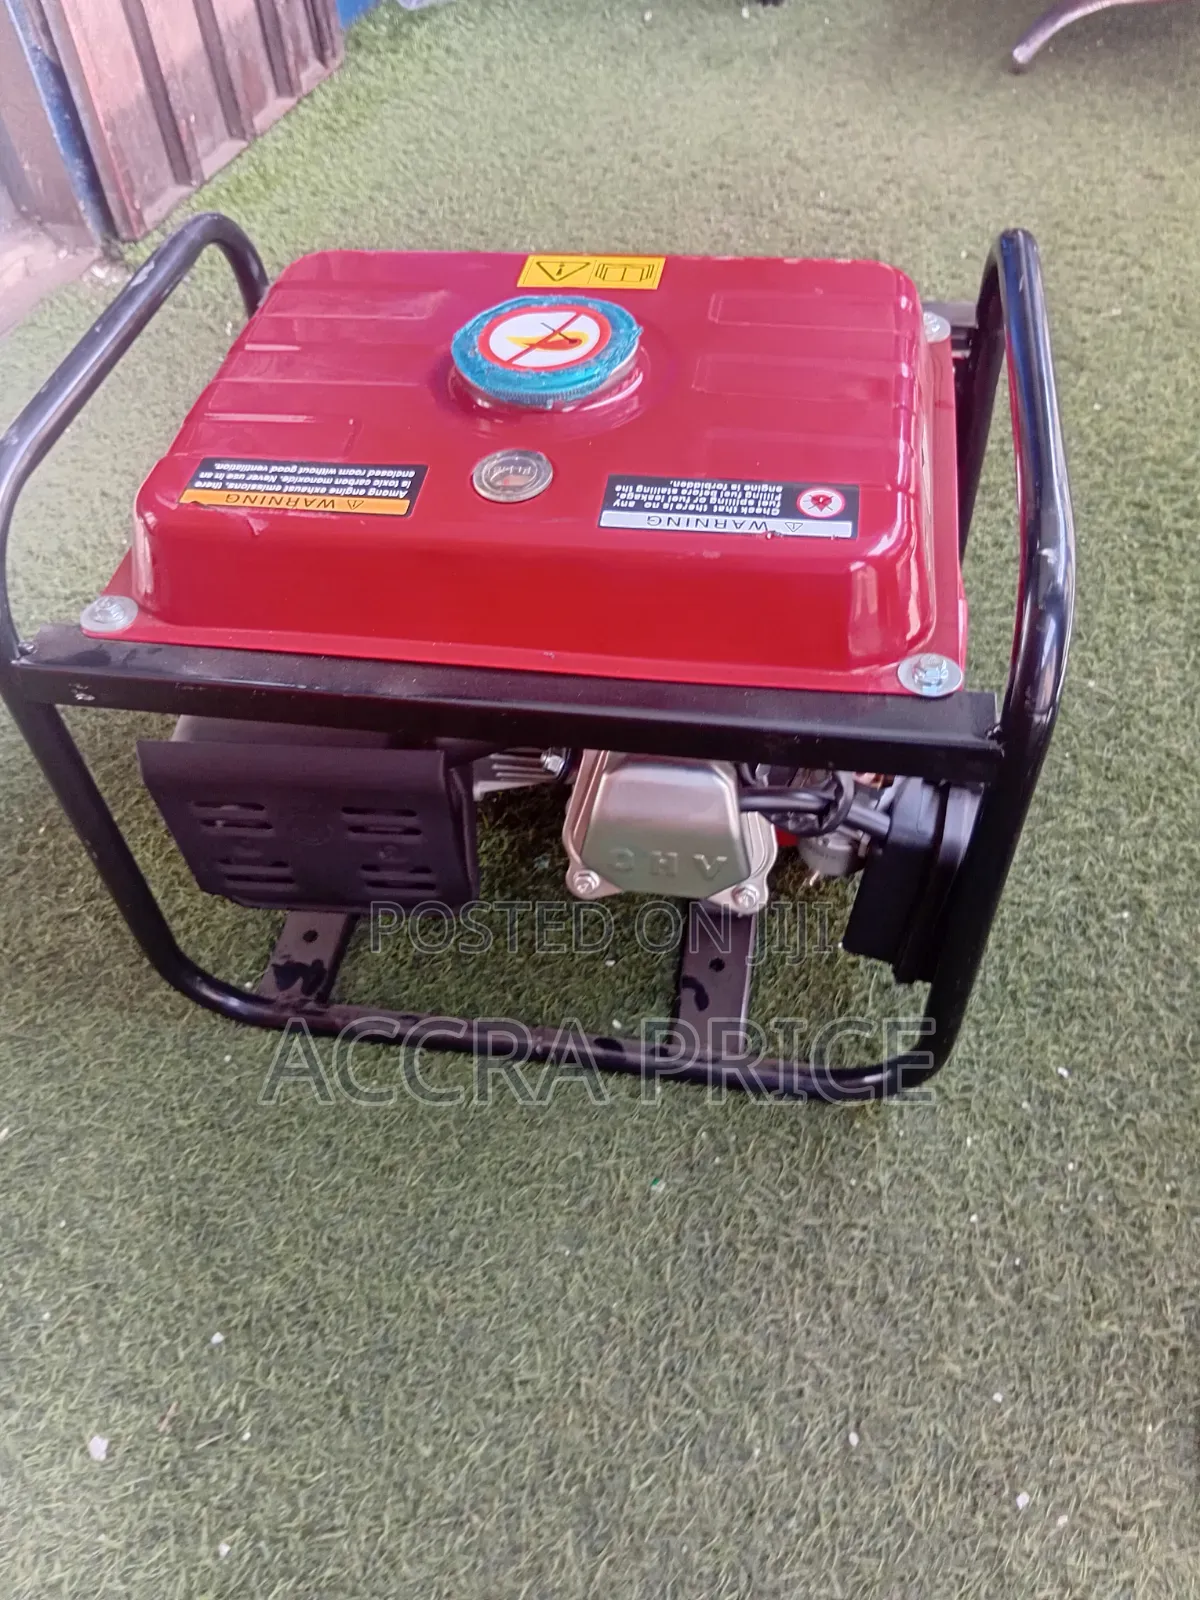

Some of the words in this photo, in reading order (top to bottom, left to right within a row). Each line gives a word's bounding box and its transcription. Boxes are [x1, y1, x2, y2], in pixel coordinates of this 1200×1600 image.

[268, 465, 297, 473] good
[299, 467, 336, 475] without
[338, 468, 366, 476] room
[366, 469, 415, 478] enclosed
[214, 472, 225, 480] in
[246, 474, 277, 483] Never
[194, 481, 222, 490] there
[334, 478, 371, 486] carbon
[373, 479, 399, 488] toxic
[401, 480, 412, 489] is
[282, 485, 327, 494] exhaust
[329, 487, 366, 496] engine
[368, 488, 408, 498] Among
[614, 485, 634, 493] the
[743, 484, 783, 493] engine
[668, 495, 691, 504] fuel
[720, 491, 742, 499] fuel
[225, 494, 335, 509] WARNING
[612, 499, 635, 508] any
[643, 501, 660, 509] no
[757, 500, 781, 508] fuel
[662, 502, 674, 511] is
[675, 503, 708, 512] there
[713, 505, 737, 514] that
[740, 506, 780, 516] Check
[646, 516, 768, 531] WARNING
[608, 848, 728, 881] OHV
